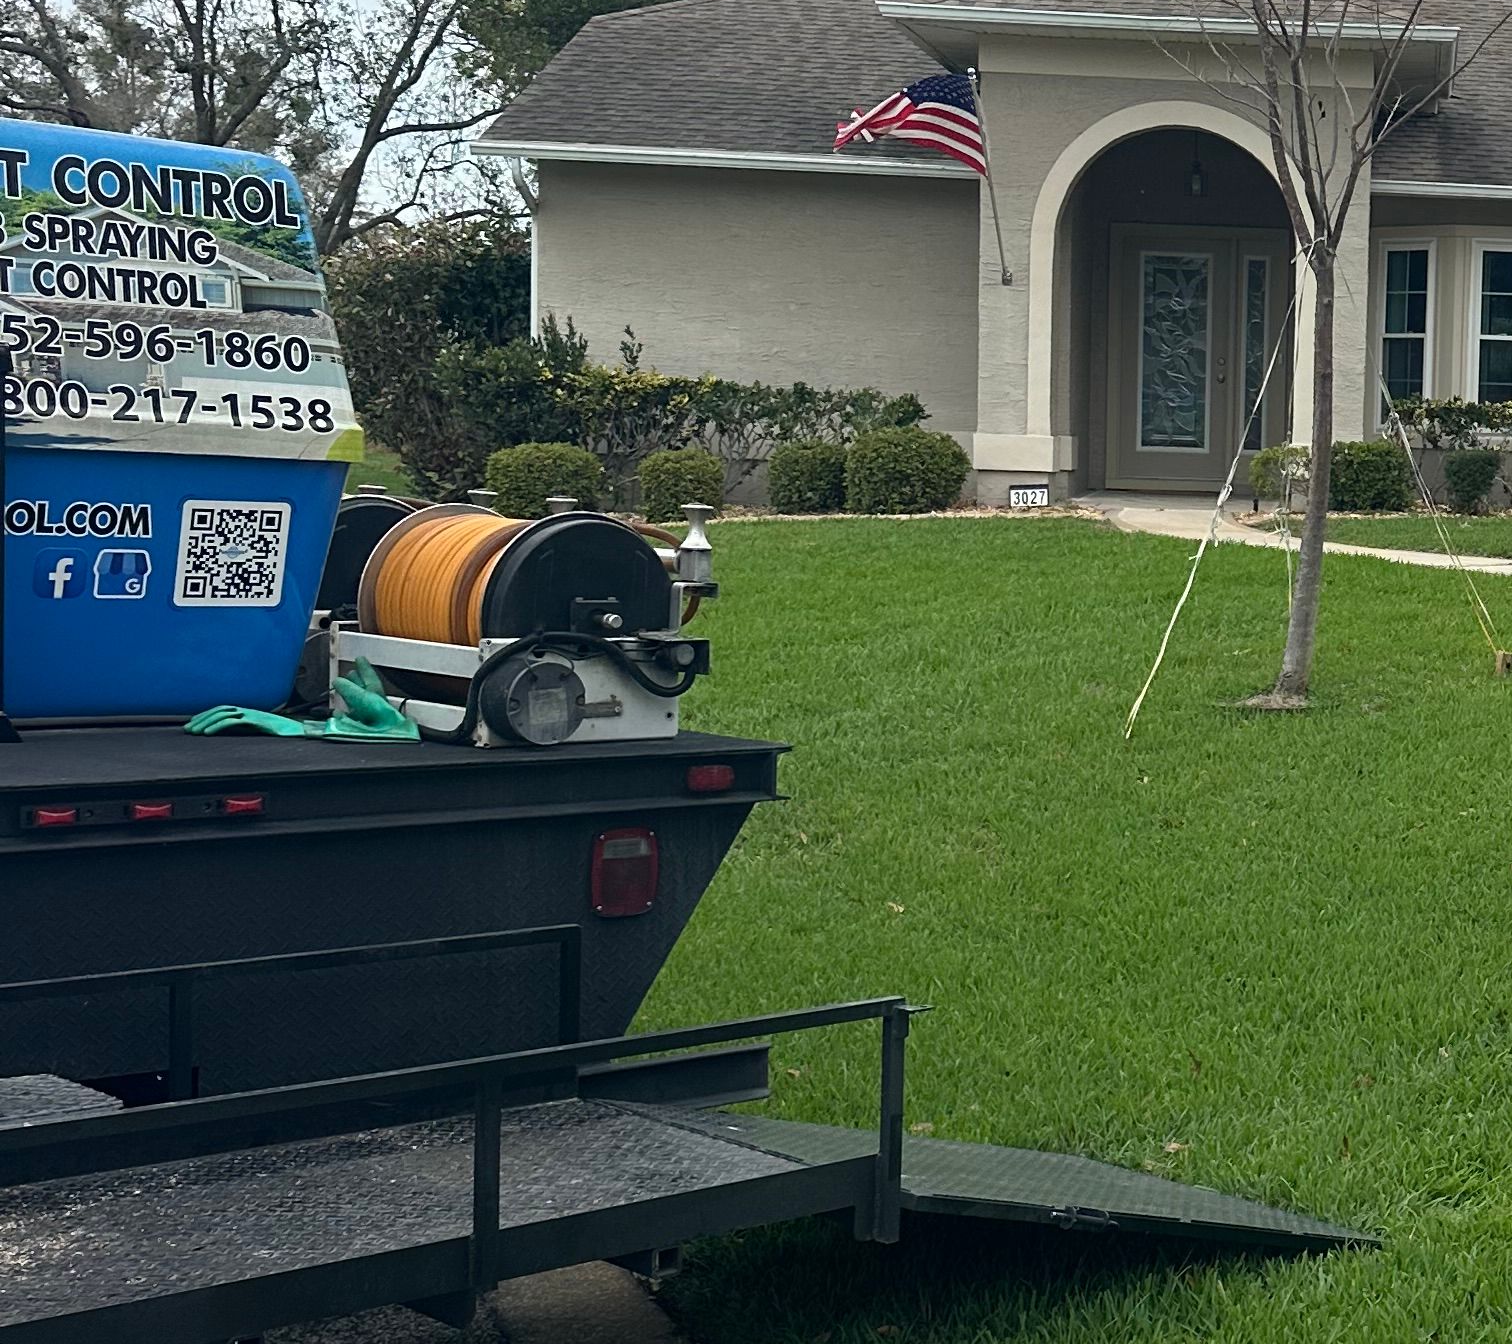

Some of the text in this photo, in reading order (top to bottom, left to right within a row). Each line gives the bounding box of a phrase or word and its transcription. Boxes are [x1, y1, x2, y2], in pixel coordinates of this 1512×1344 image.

[53, 156, 299, 227] CONTROL
[24, 214, 217, 265] SPRAYING
[33, 261, 207, 308] CONTROL
[4, 377, 335, 433] 800-217-1538
[1013, 490, 1046, 505] 3027
